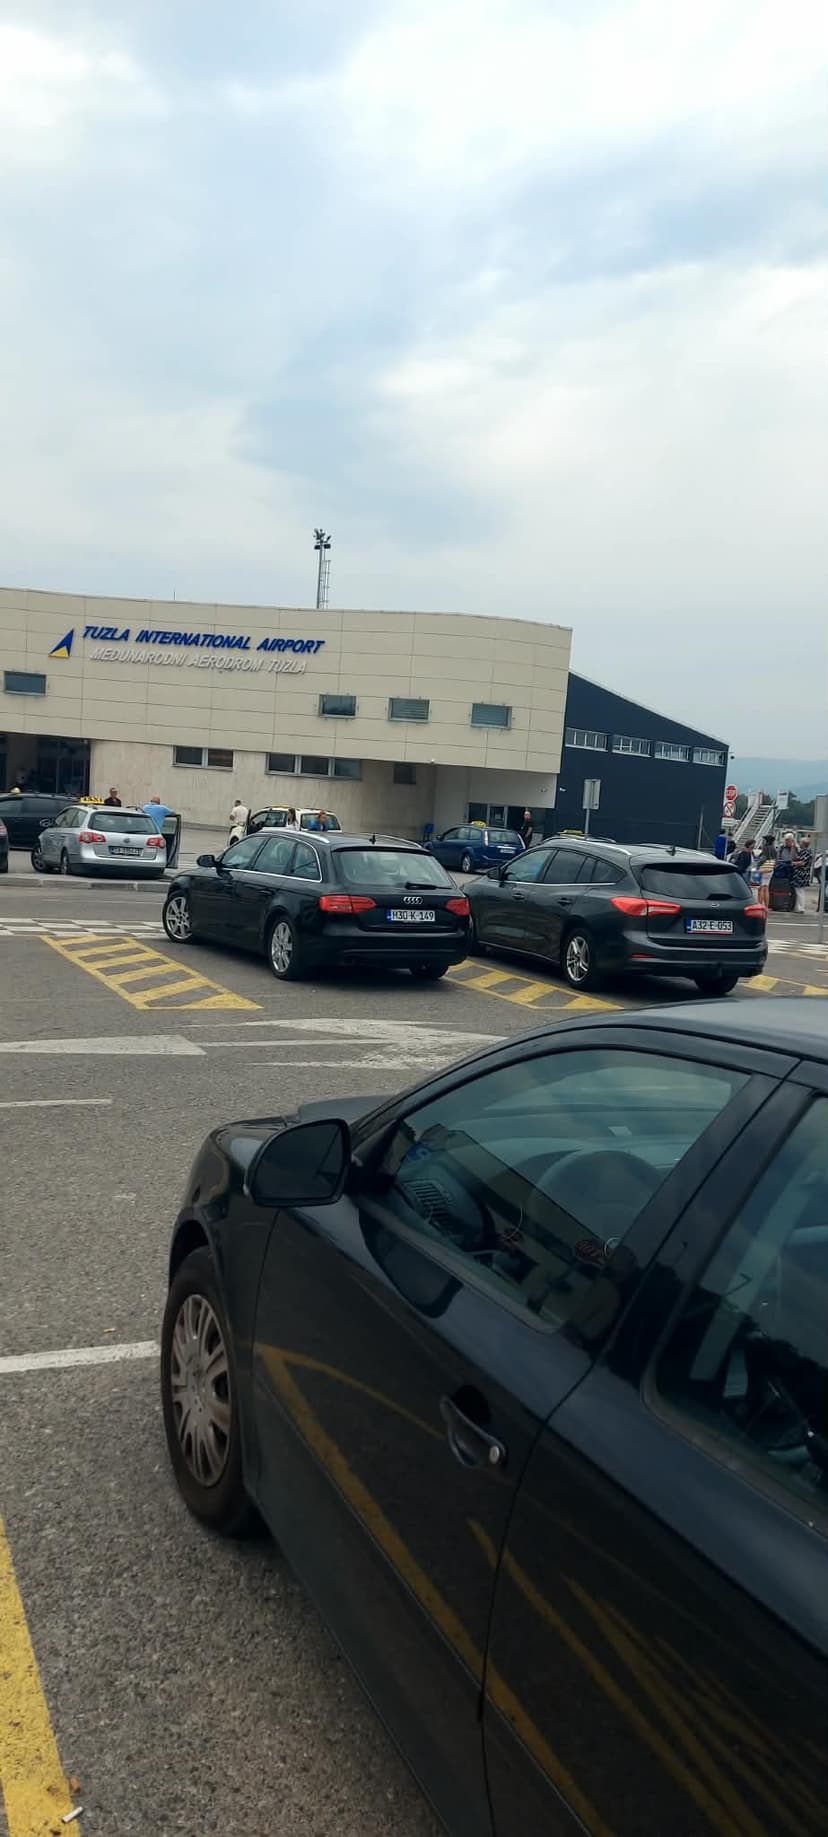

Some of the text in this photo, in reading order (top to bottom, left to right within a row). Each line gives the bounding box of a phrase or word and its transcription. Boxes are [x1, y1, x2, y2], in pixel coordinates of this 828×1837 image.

[83, 626, 325, 654] TUZLA INTERNATIONAL AIRPORT
[188, 655, 263, 673] AERODROM
[267, 659, 306, 675] TUZLA
